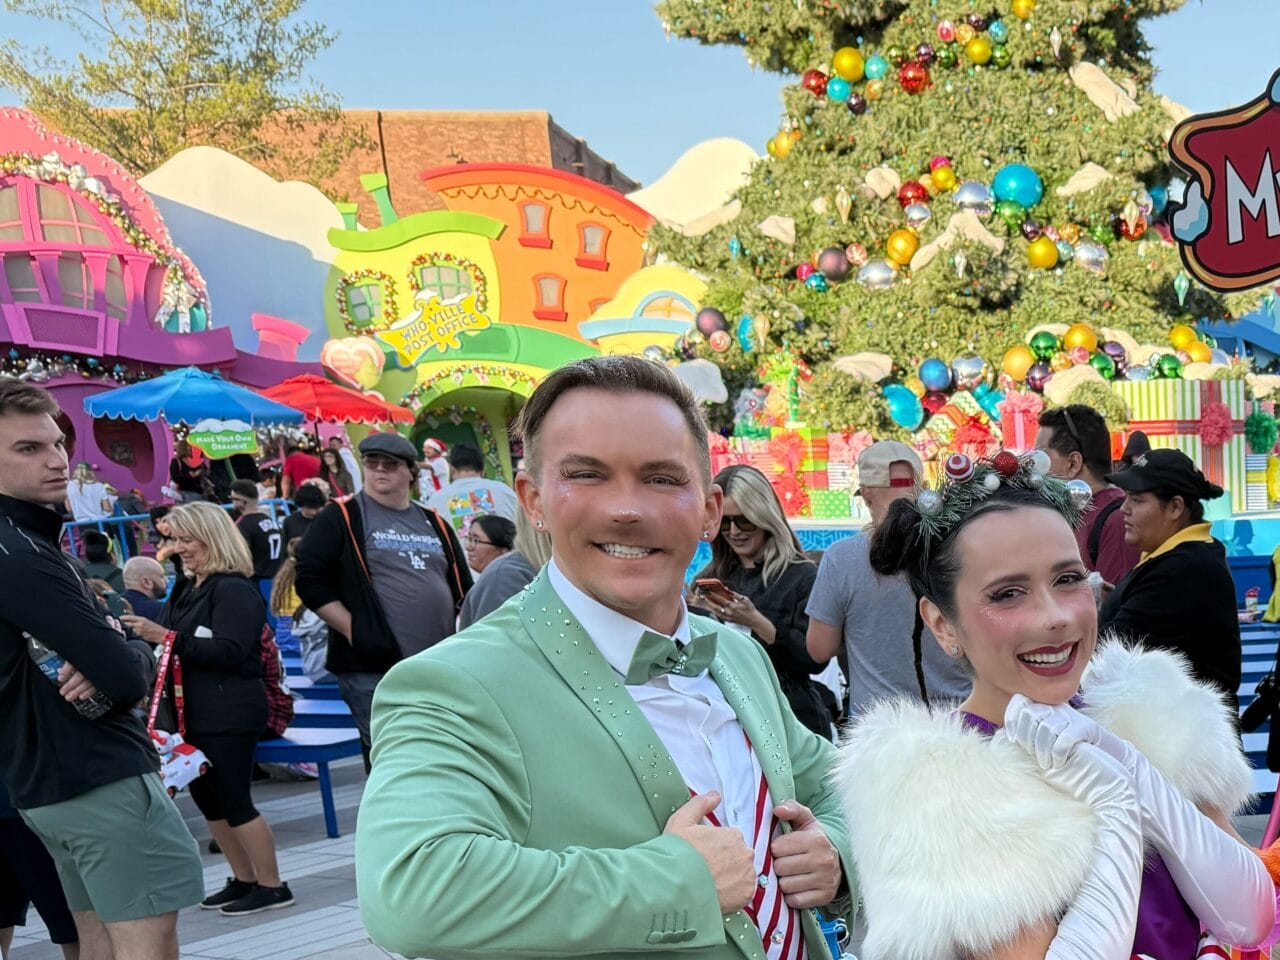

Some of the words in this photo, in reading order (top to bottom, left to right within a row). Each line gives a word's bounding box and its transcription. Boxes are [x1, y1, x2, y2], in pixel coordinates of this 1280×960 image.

[404, 331, 434, 356] POST
[437, 313, 478, 337] OFFICE
[269, 533, 281, 560] 17
